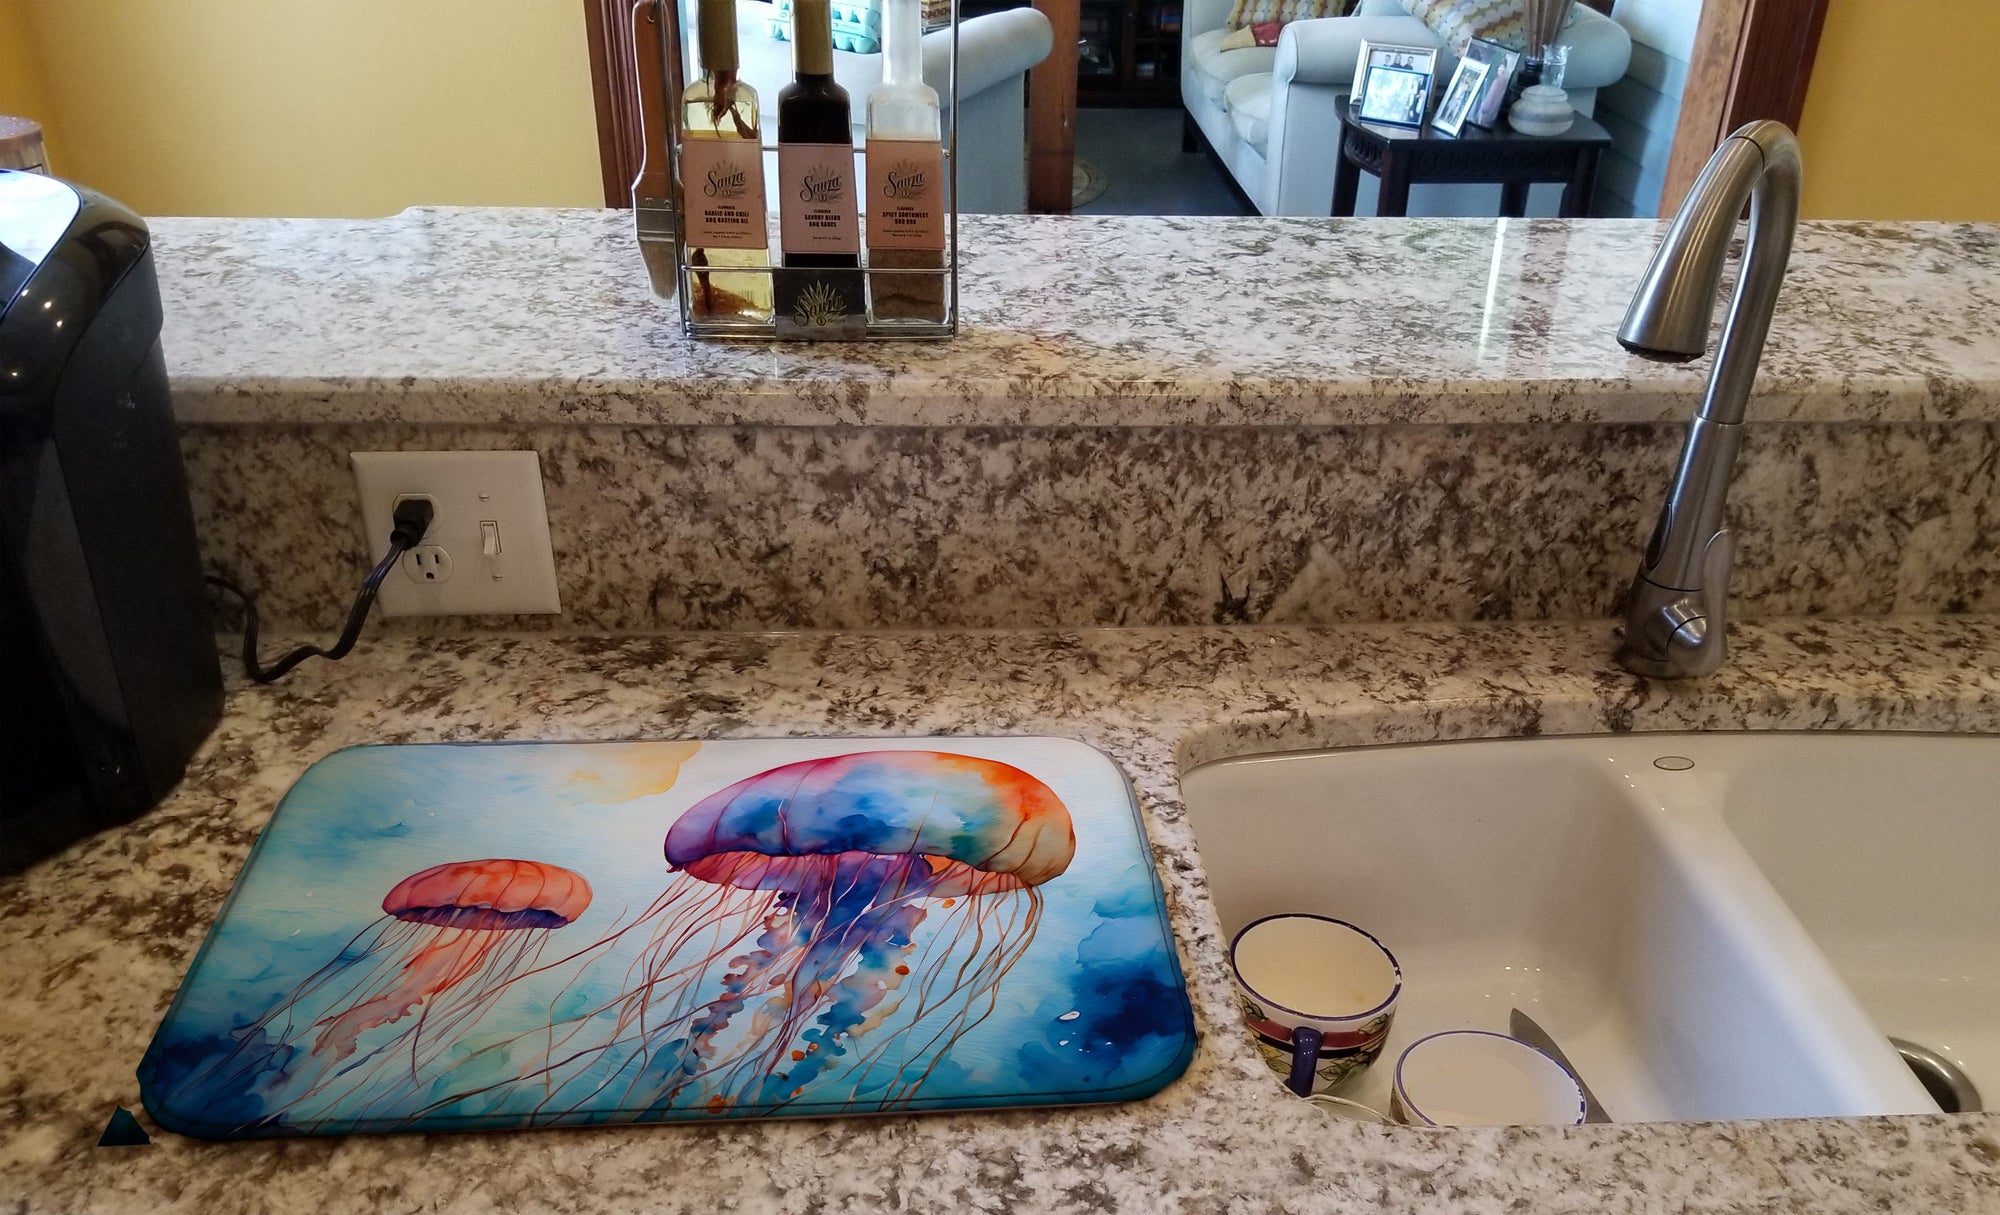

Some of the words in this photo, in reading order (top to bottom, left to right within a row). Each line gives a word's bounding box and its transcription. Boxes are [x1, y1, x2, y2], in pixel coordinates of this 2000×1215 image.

[703, 170, 746, 197] Sauza
[800, 175, 842, 202] Sauza
[884, 170, 925, 198] Sauza
